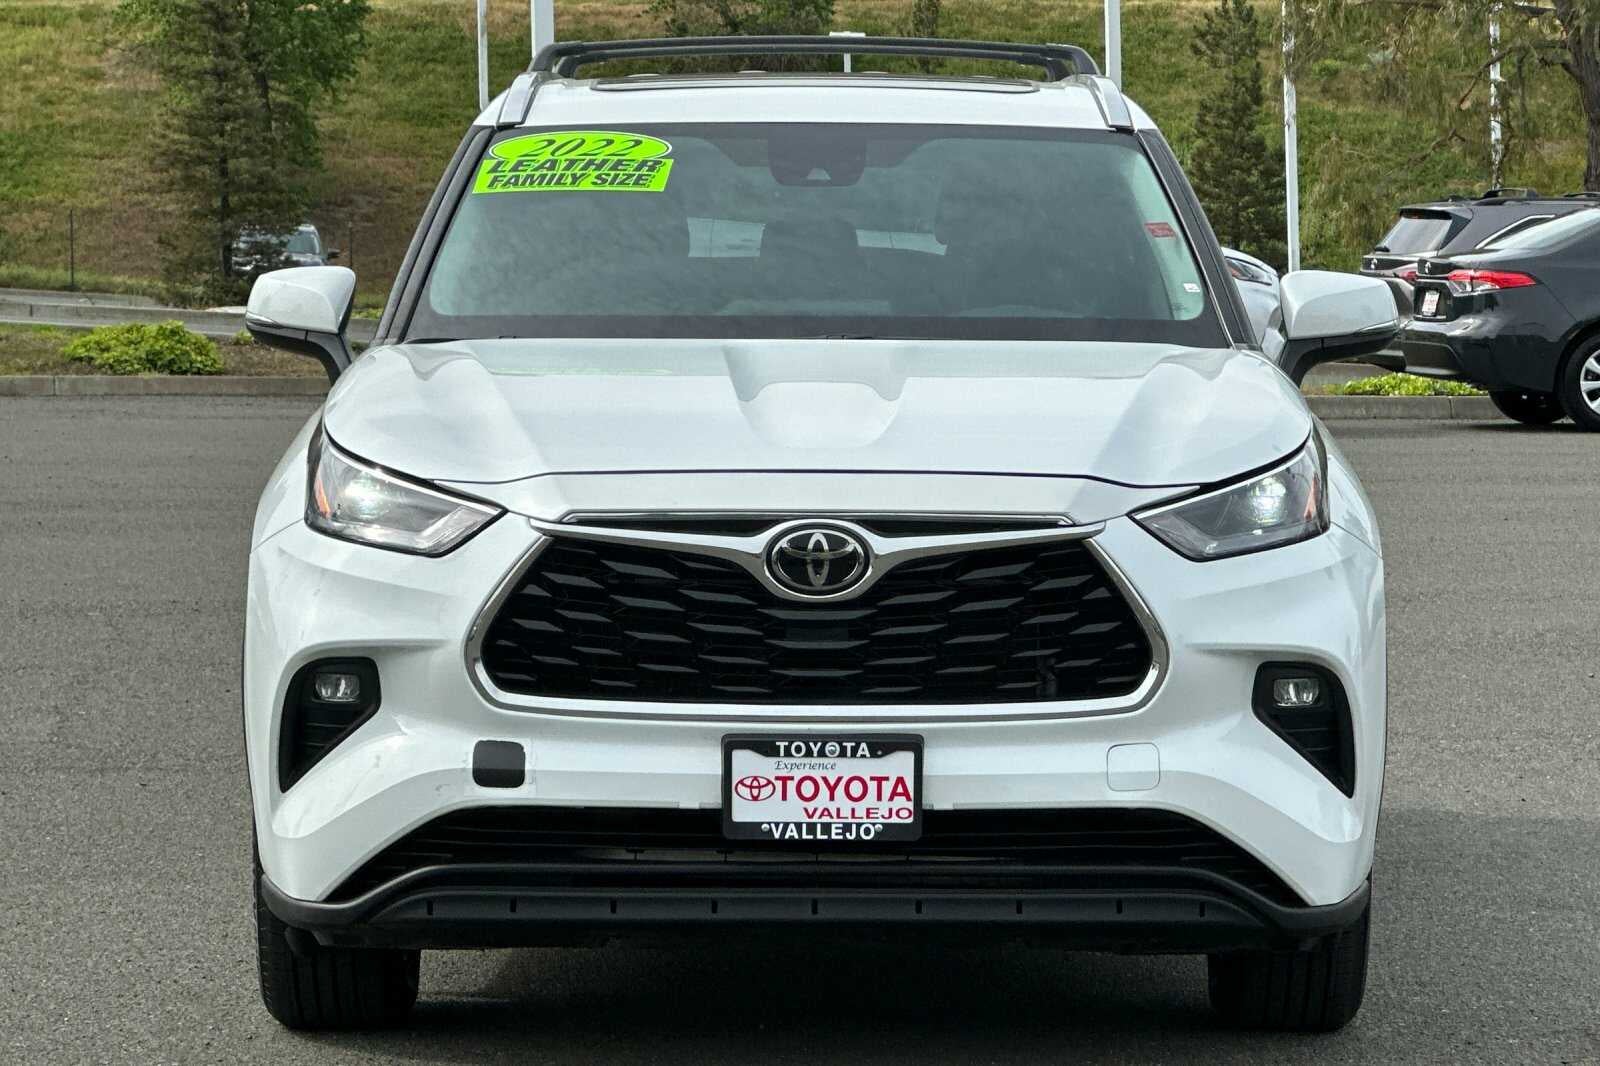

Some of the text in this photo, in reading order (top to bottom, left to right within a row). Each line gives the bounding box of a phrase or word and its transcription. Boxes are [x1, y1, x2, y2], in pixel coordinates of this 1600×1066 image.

[517, 137, 644, 157] 2022
[487, 158, 665, 174] LEATHER
[488, 173, 654, 189] FAMILY SIZE
[776, 741, 871, 758] TOYOTA
[774, 760, 837, 773] Experience
[774, 775, 913, 803] TOYOTA
[803, 807, 913, 820] VALLEJO
[770, 823, 876, 840] VALLEJO
